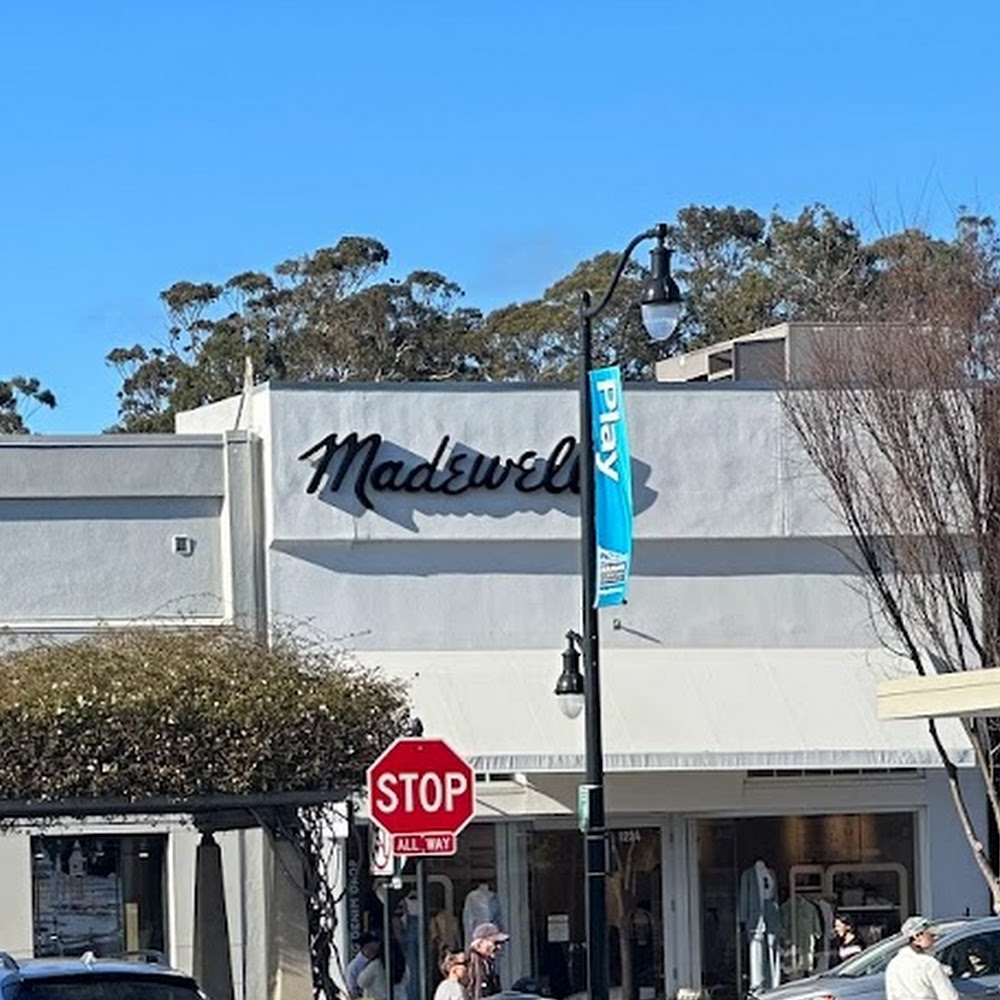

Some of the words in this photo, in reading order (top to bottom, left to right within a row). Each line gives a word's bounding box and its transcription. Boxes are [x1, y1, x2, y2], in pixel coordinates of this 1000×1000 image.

[596, 379, 619, 483] Play
[376, 771, 468, 814] STOP
[397, 837, 418, 851] ALL
[424, 837, 450, 851] WAY
